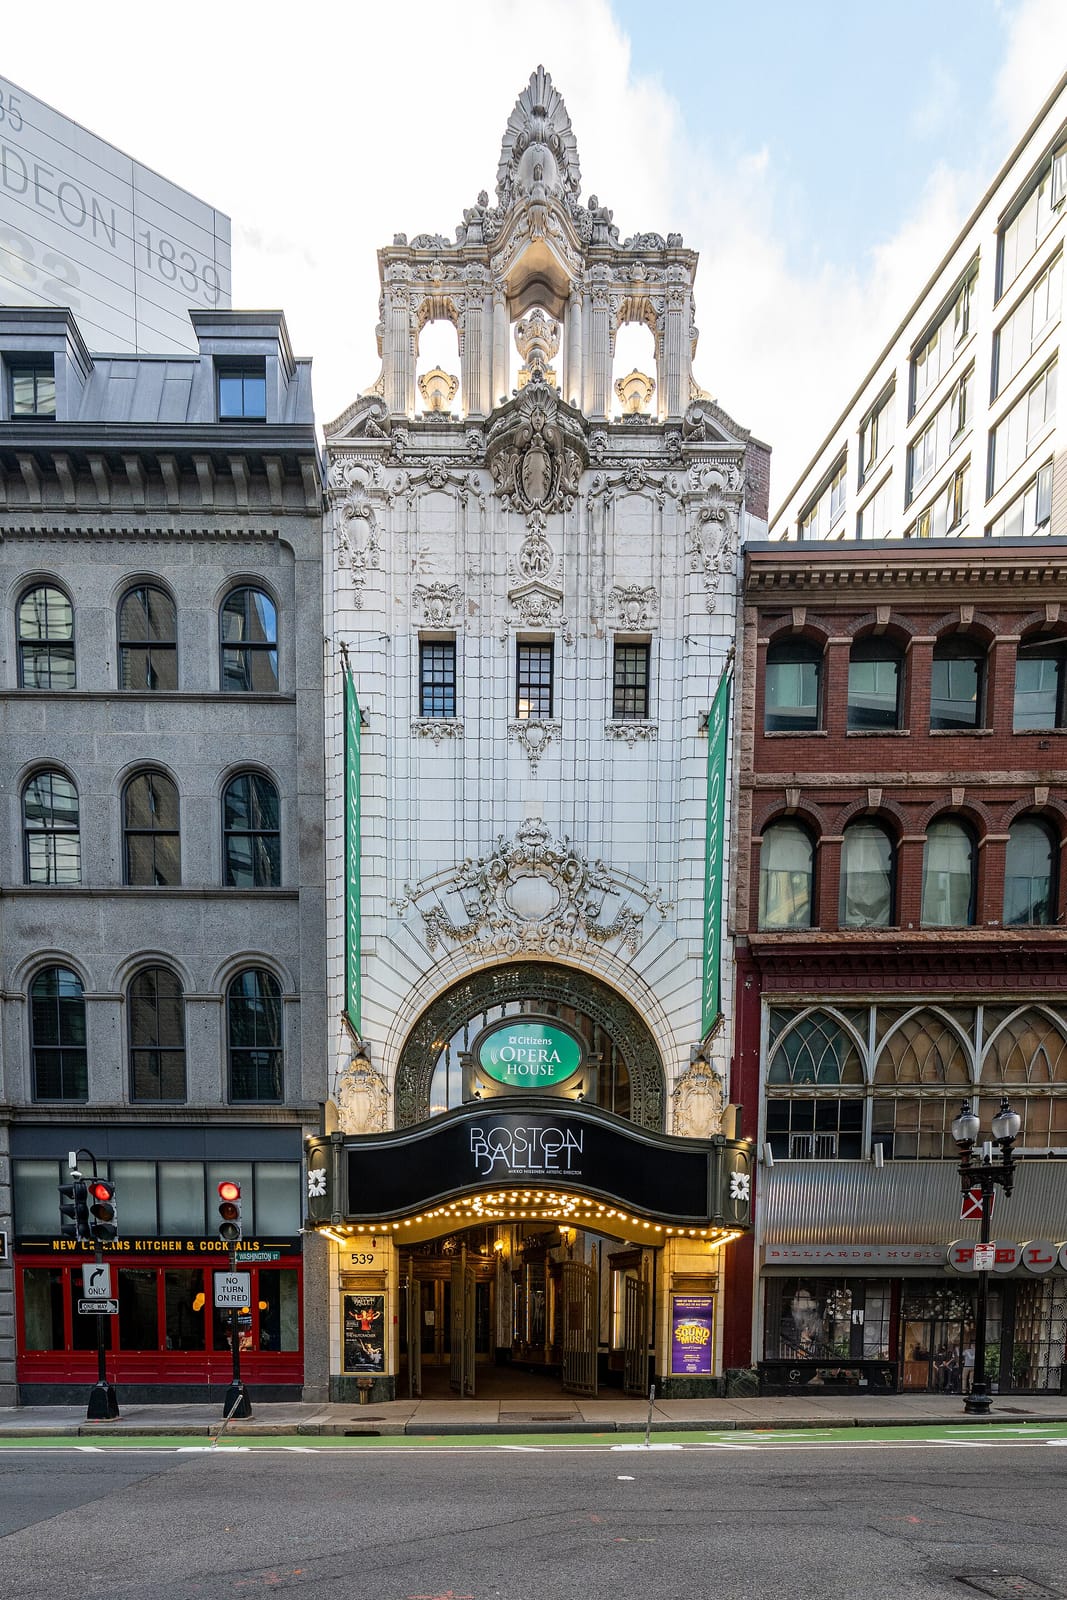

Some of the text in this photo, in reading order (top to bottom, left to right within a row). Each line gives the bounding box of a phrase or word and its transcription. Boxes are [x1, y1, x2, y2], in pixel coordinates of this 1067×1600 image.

[139, 230, 220, 304] 1839
[350, 769, 358, 1014] OPERA HOUSE
[705, 772, 720, 1017] OPERA HOUSE
[517, 1036, 552, 1045] Citizens
[500, 1046, 561, 1064] OPERA
[507, 1064, 554, 1075] HOUSE
[470, 1127, 583, 1153] BOSTON
[474, 1143, 577, 1175] BALLET
[53, 1240, 260, 1251] NEW REANS KITCHEN & COCKAILS
[239, 1252, 271, 1260] WASHINGTON
[351, 1253, 374, 1264] 539
[955, 1248, 1067, 1264] FEL
[675, 1327, 710, 1341] SOUND
[681, 1335, 707, 1345] MUSIC
